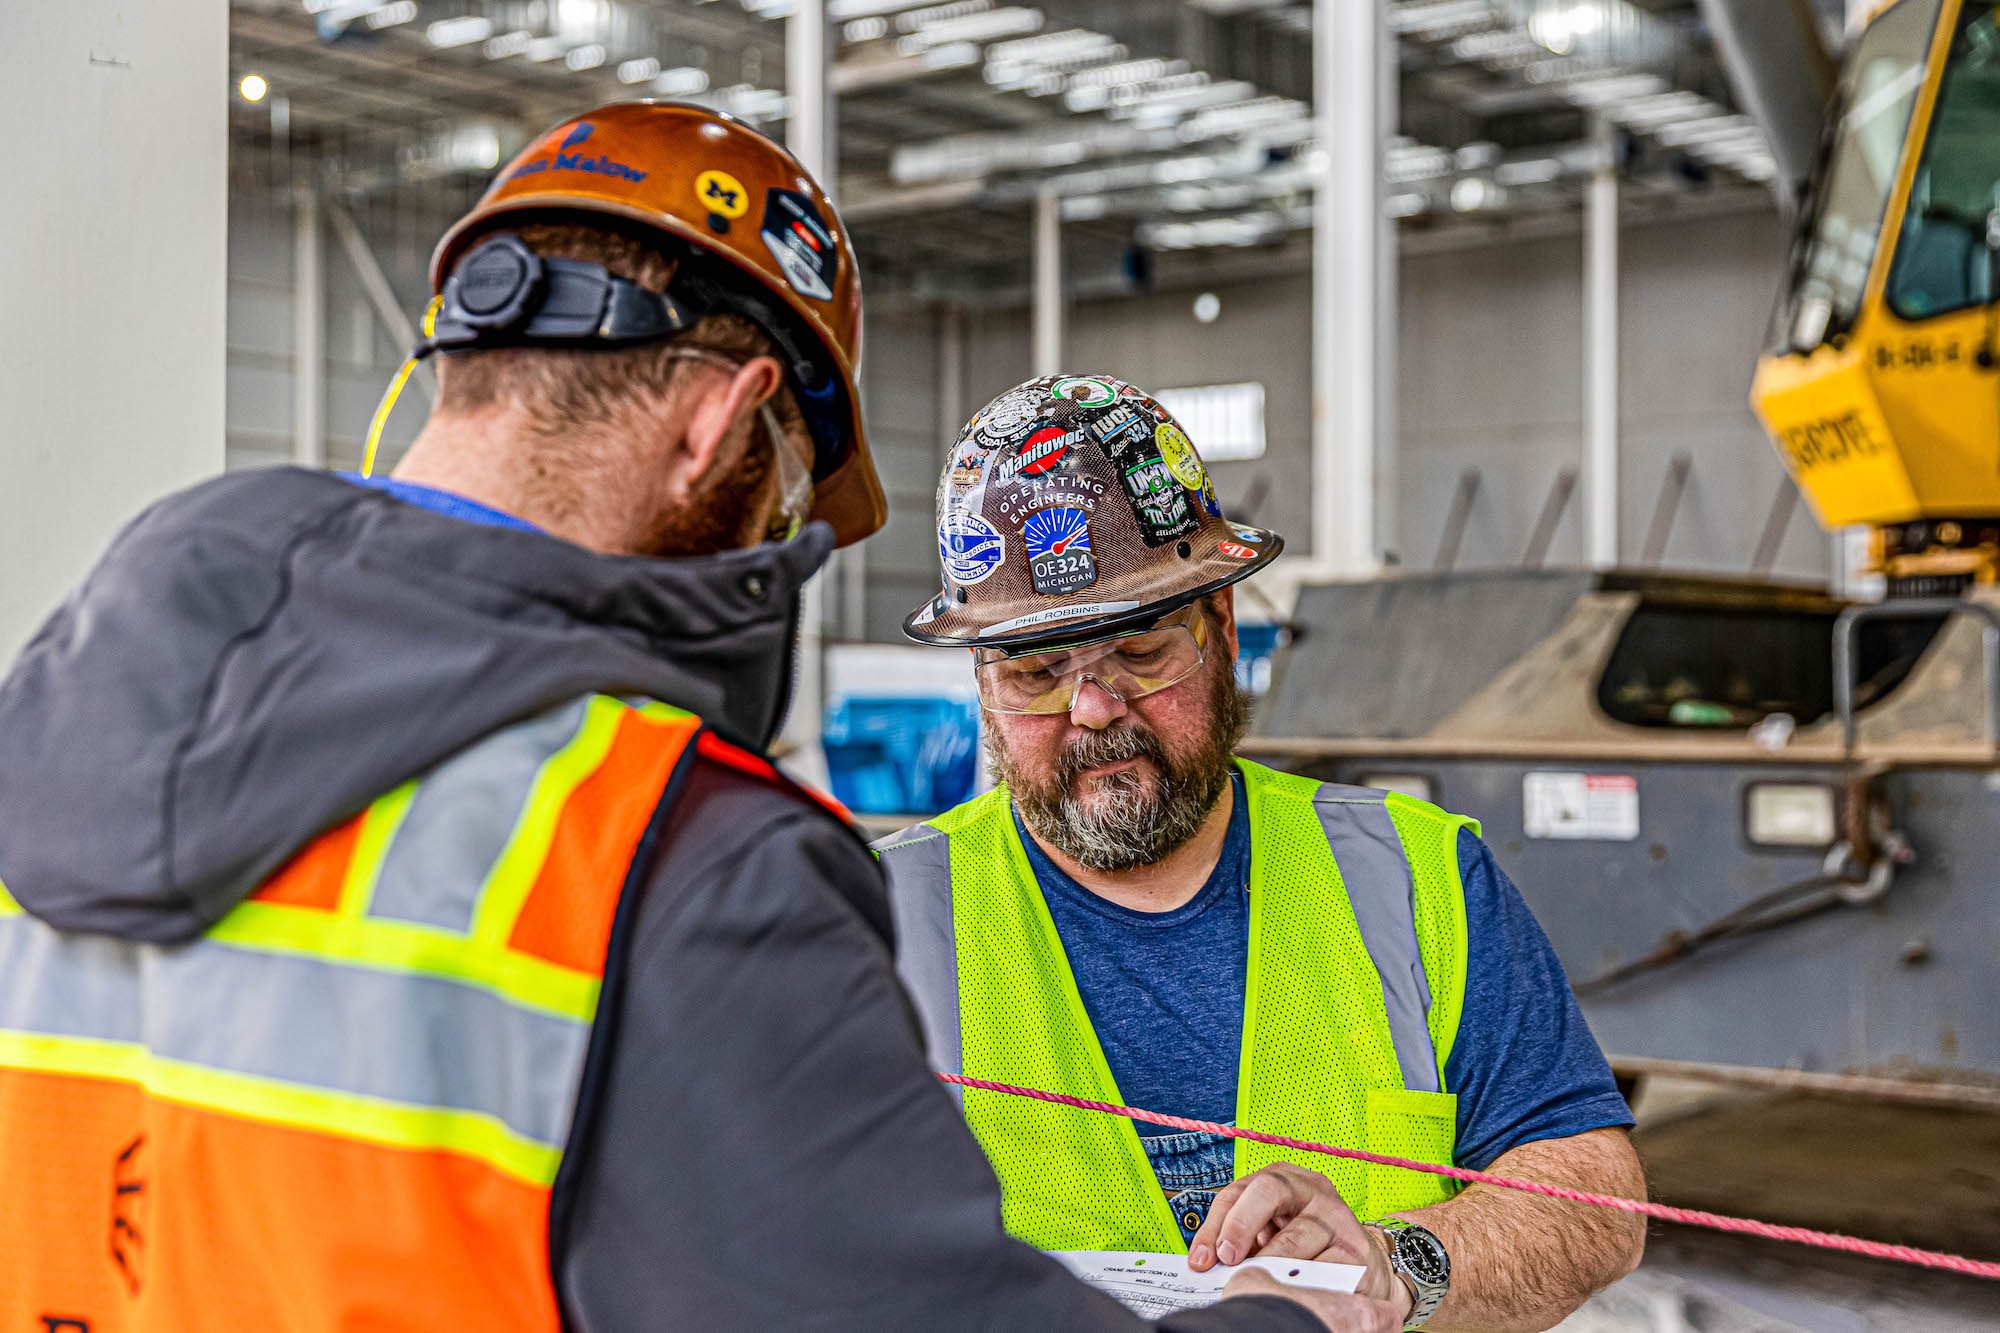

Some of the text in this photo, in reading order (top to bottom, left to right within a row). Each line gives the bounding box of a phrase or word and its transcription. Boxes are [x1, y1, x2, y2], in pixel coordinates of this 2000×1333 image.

[706, 179, 737, 209] M
[976, 423, 1038, 449] LOCAL 324
[1124, 420, 1152, 443] 324
[998, 429, 1085, 482] Manitowoc
[1001, 477, 1104, 513] OPERATING
[1010, 493, 1095, 525] ENGINEERS
[1035, 554, 1090, 578] OE324
[1038, 572, 1092, 589] MICHIGAN
[1015, 604, 1099, 627] PHIL ROBBINS
